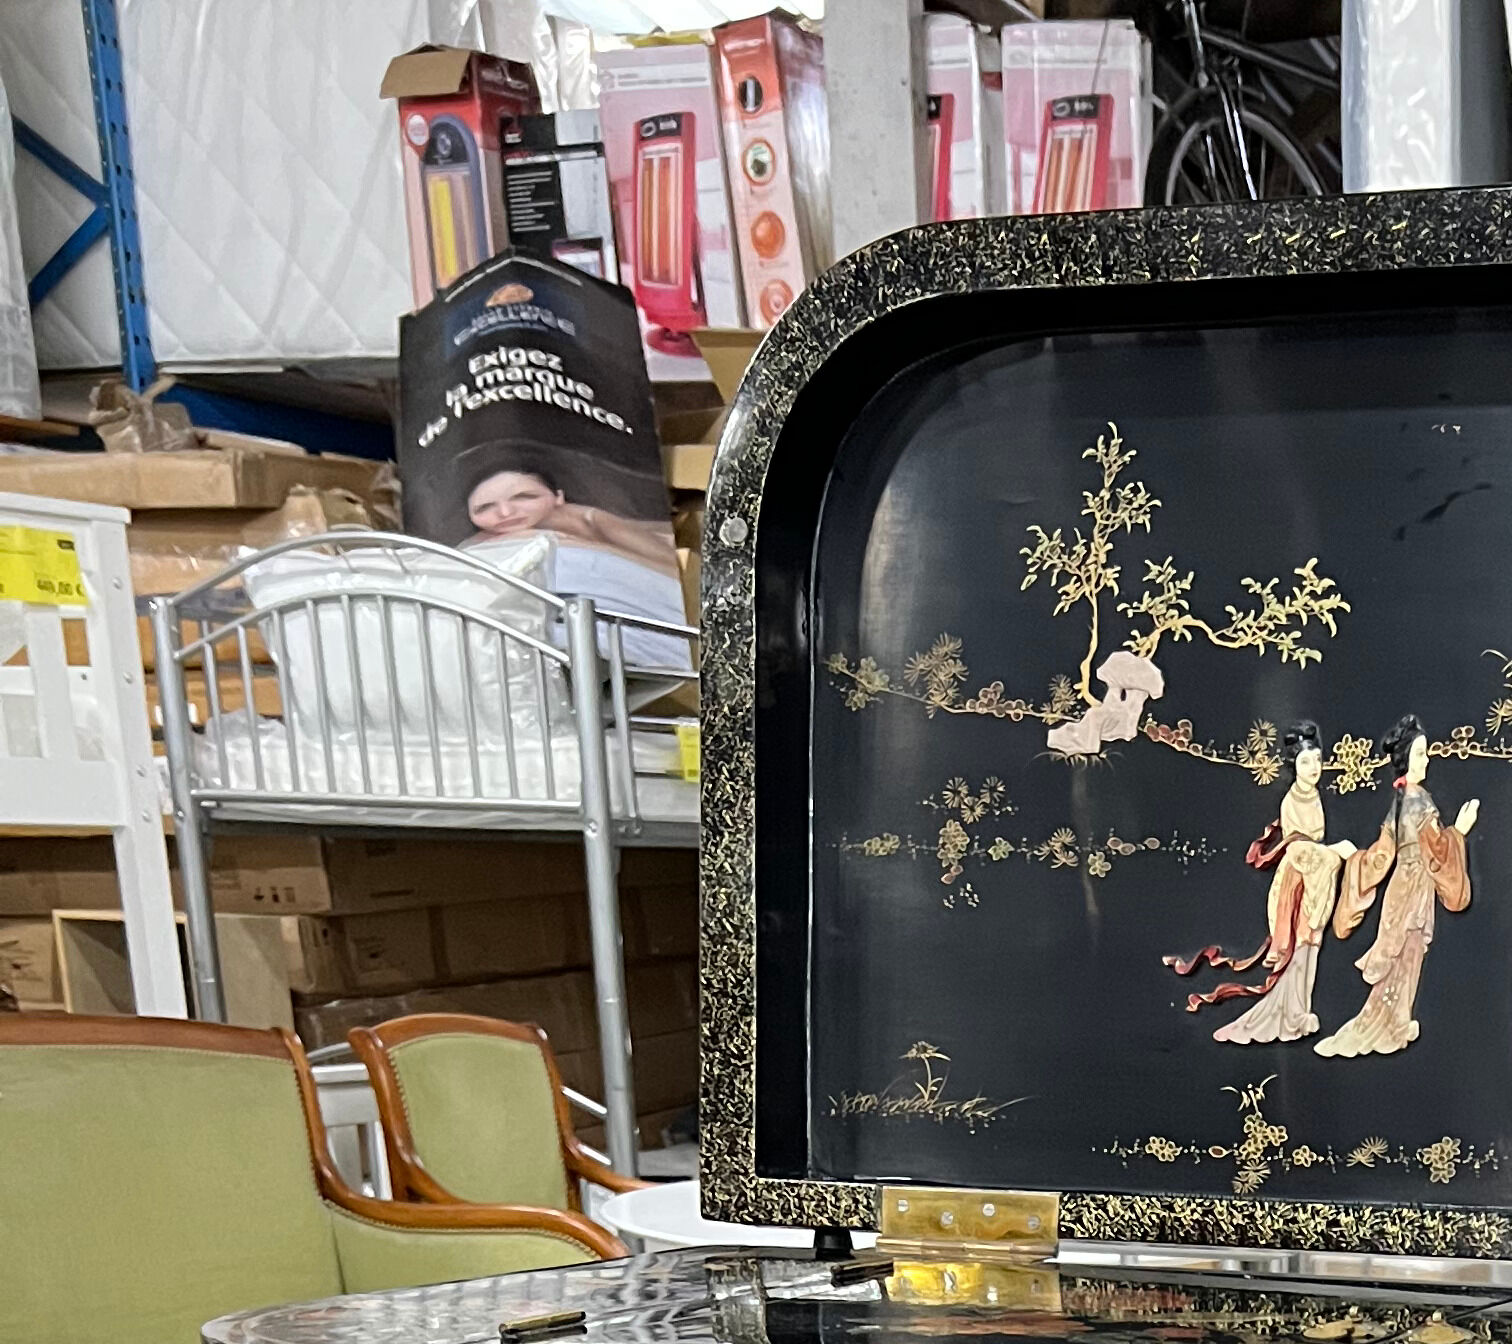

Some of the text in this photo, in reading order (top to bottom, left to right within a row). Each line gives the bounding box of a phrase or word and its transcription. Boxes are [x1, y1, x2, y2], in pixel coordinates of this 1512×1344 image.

[468, 346, 563, 374] Exigez
[446, 366, 594, 407] la marque
[418, 382, 634, 448] de l'excellence.
